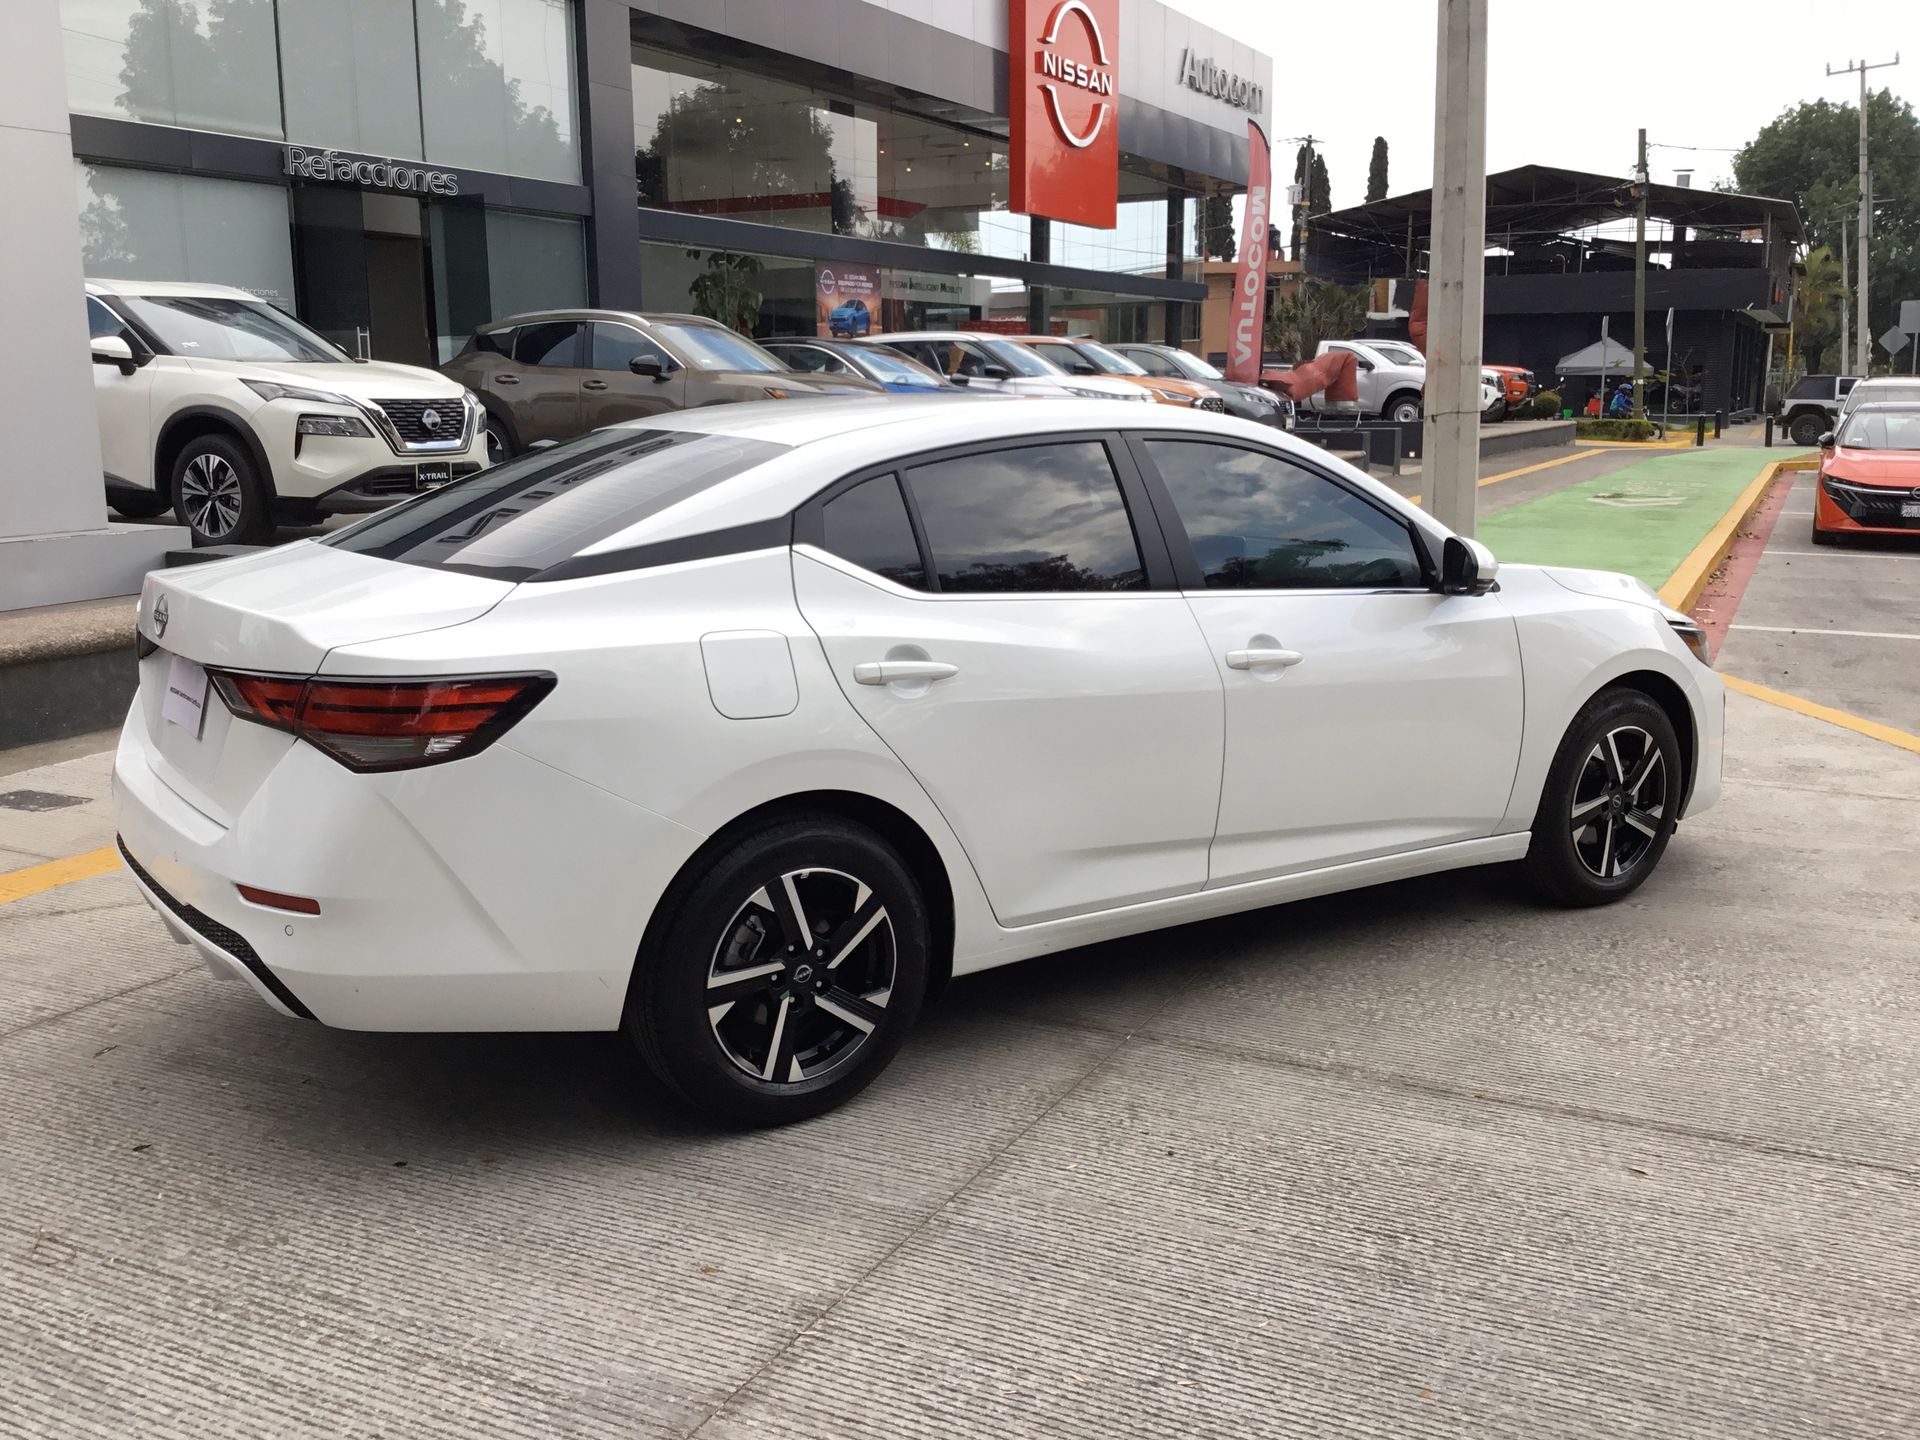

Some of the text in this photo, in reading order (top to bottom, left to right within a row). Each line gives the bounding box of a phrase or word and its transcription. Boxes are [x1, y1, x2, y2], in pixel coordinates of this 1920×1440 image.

[1042, 50, 1113, 96] NISSAN
[1179, 45, 1263, 114] Autocom
[287, 145, 459, 196] Refacciones
[239, 286, 279, 297] facciones
[1234, 185, 1266, 366] AUTOCOM
[419, 472, 449, 481] X-TRAIL
